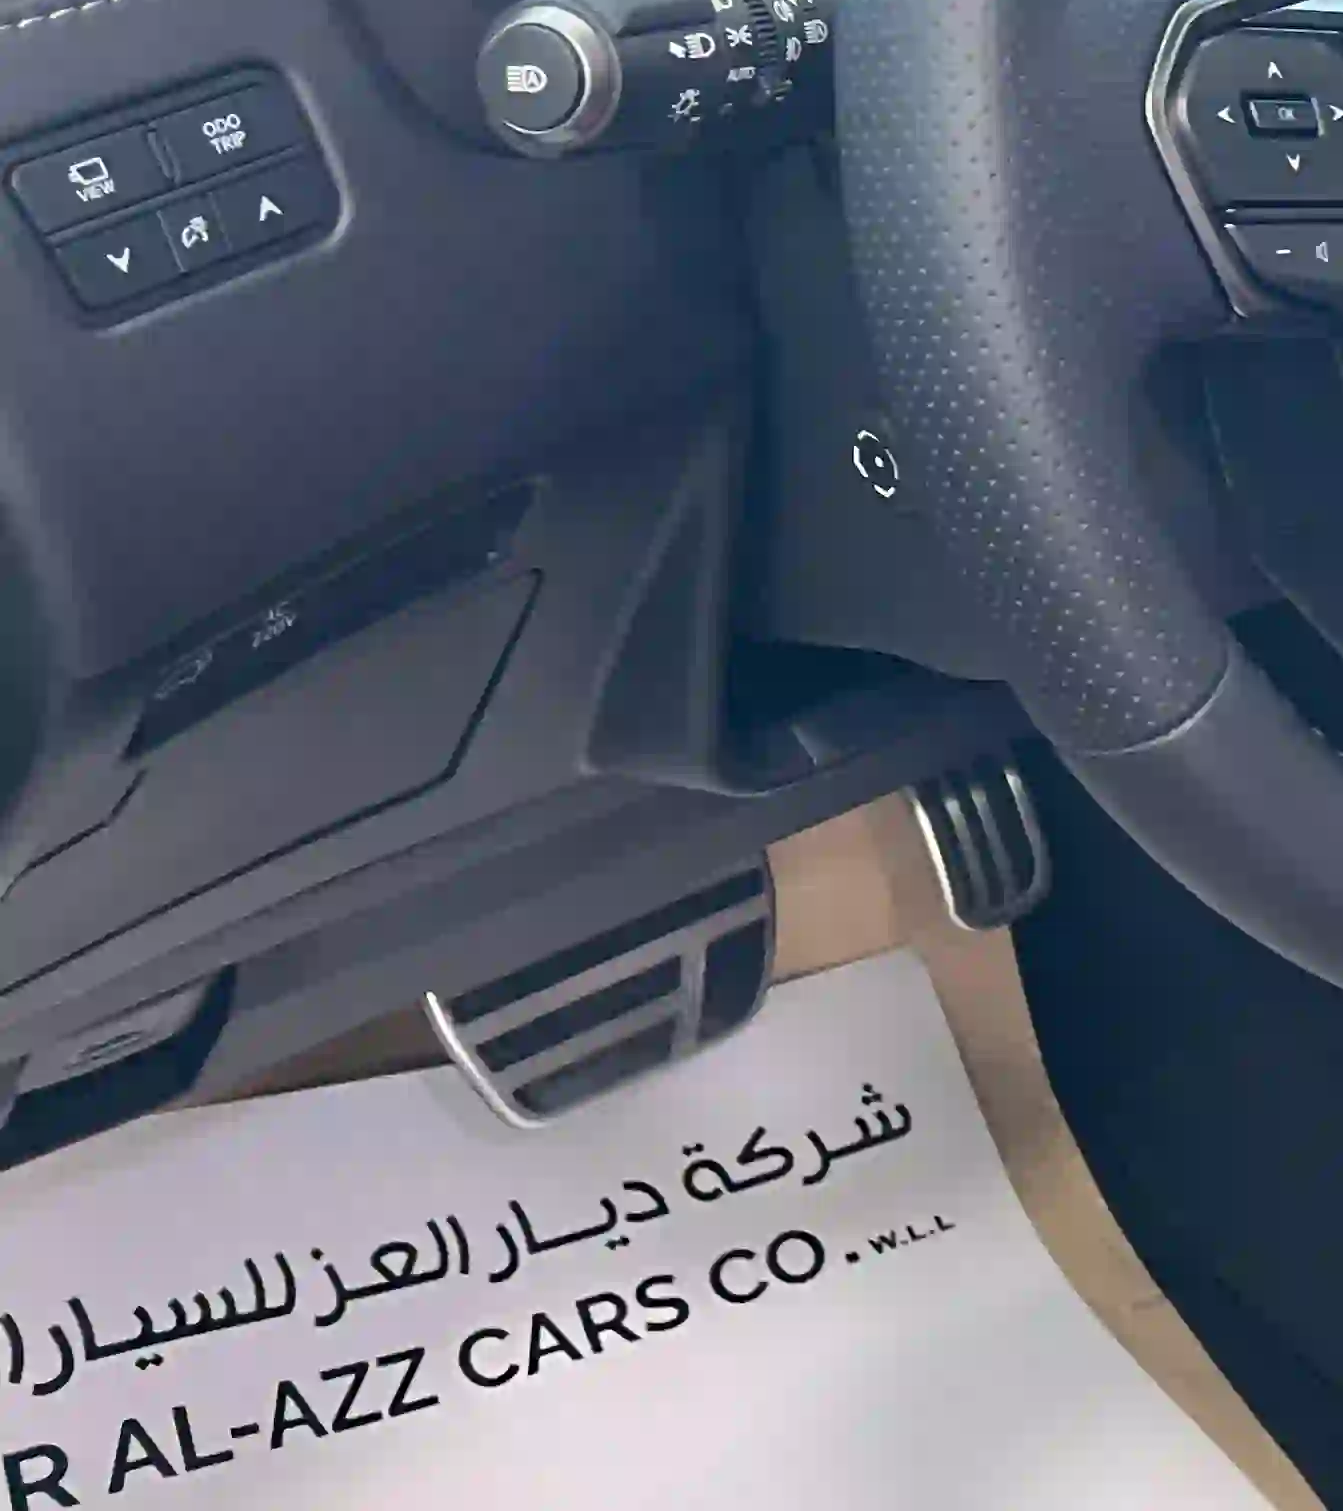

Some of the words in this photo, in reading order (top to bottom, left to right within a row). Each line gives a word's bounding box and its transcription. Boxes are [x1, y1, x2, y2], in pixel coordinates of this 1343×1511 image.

[202, 113, 242, 138] ODO
[209, 130, 247, 155] TRIP
[75, 178, 117, 202] VIEW
[682, 1082, 912, 1202] شركة
[488, 1180, 670, 1284] ديار
[107, 1346, 441, 1495] AL-AZZ
[458, 1274, 690, 1388] CARS
